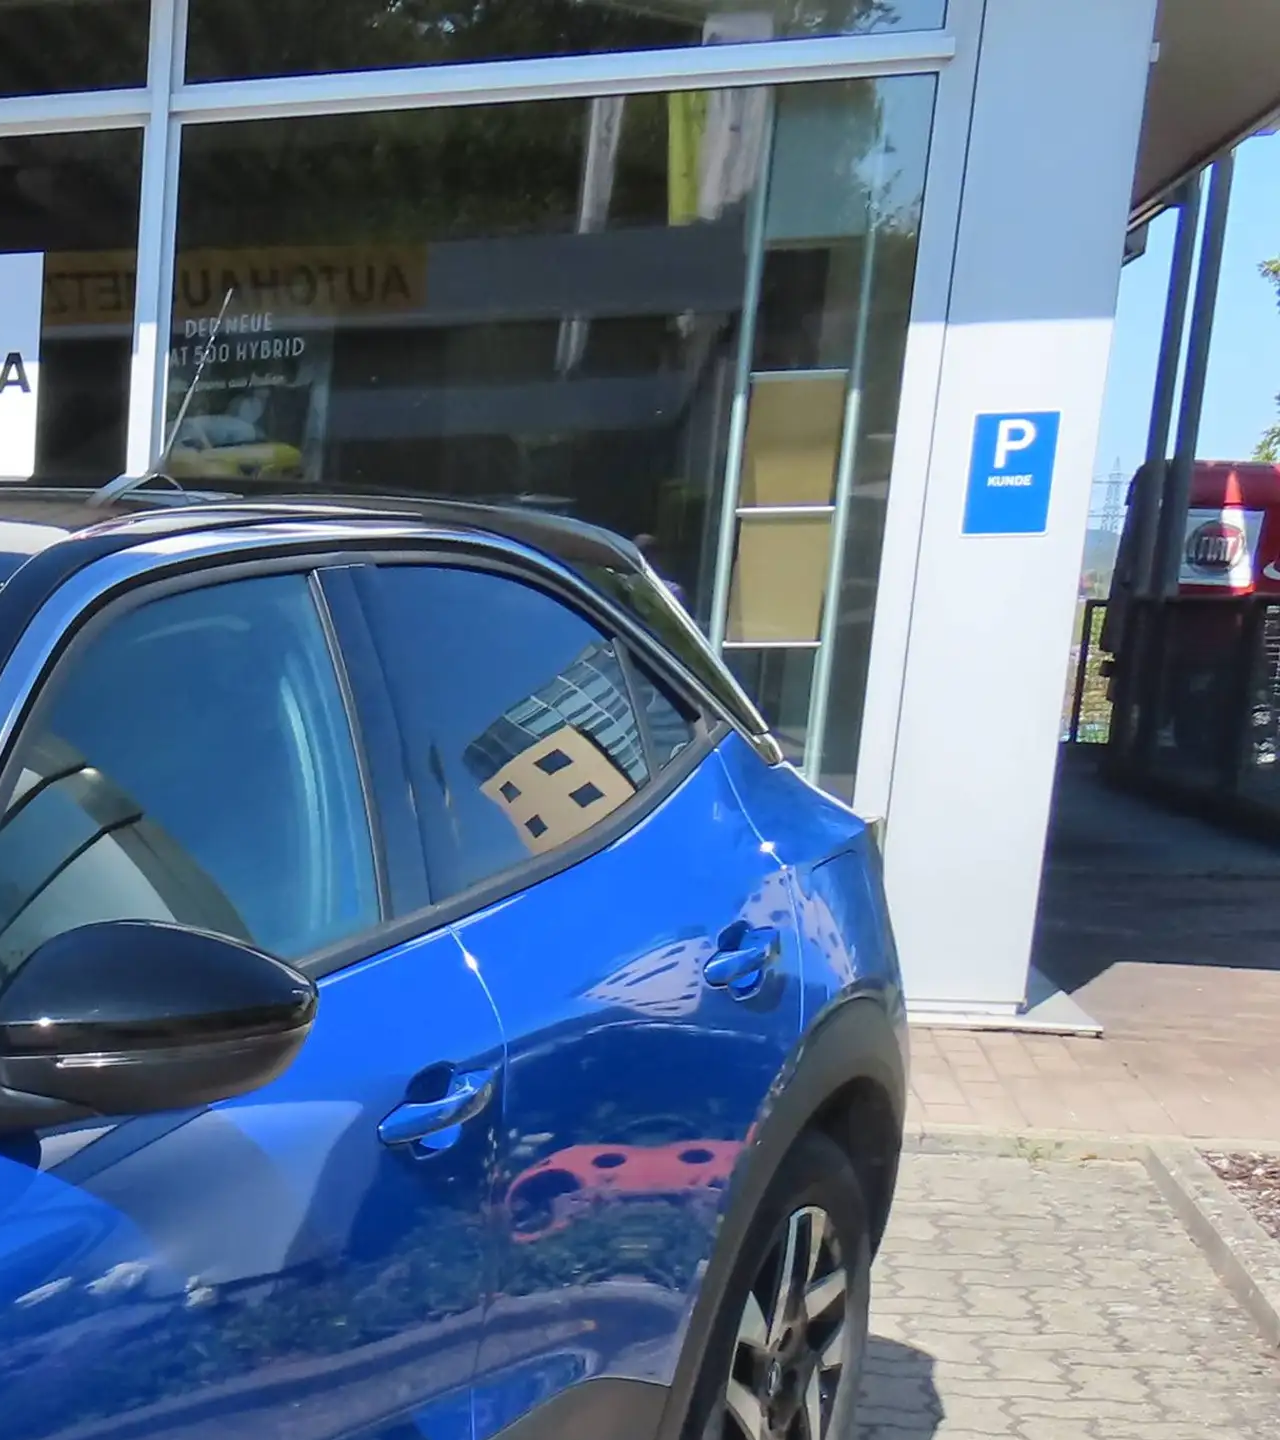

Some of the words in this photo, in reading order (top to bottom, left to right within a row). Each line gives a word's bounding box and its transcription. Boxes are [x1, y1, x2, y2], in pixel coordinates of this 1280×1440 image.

[225, 312, 273, 334] NEUE
[194, 344, 230, 366] 500
[236, 337, 305, 361] HYBRID
[994, 418, 1037, 469] P
[987, 474, 1033, 487] KUNDE
[1196, 535, 1237, 561] FIAT
